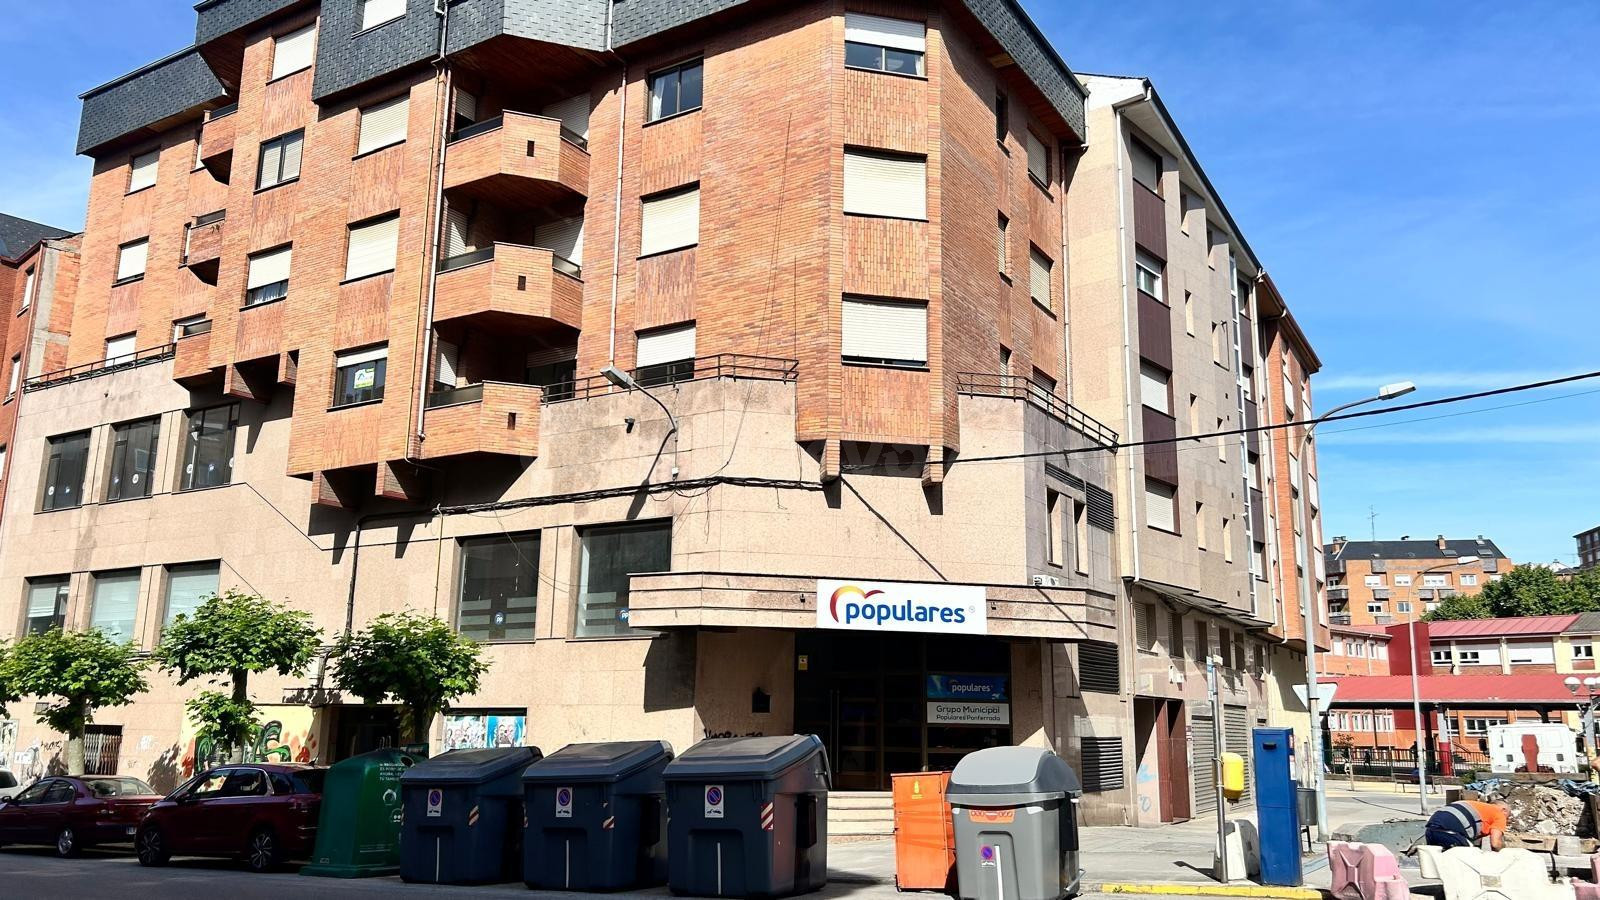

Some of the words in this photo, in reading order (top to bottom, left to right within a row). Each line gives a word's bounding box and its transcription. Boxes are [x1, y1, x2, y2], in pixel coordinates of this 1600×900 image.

[846, 600, 966, 626] populares
[951, 683, 991, 694] populares
[936, 705, 961, 715] Grupo
[962, 706, 1000, 716] Municipal
